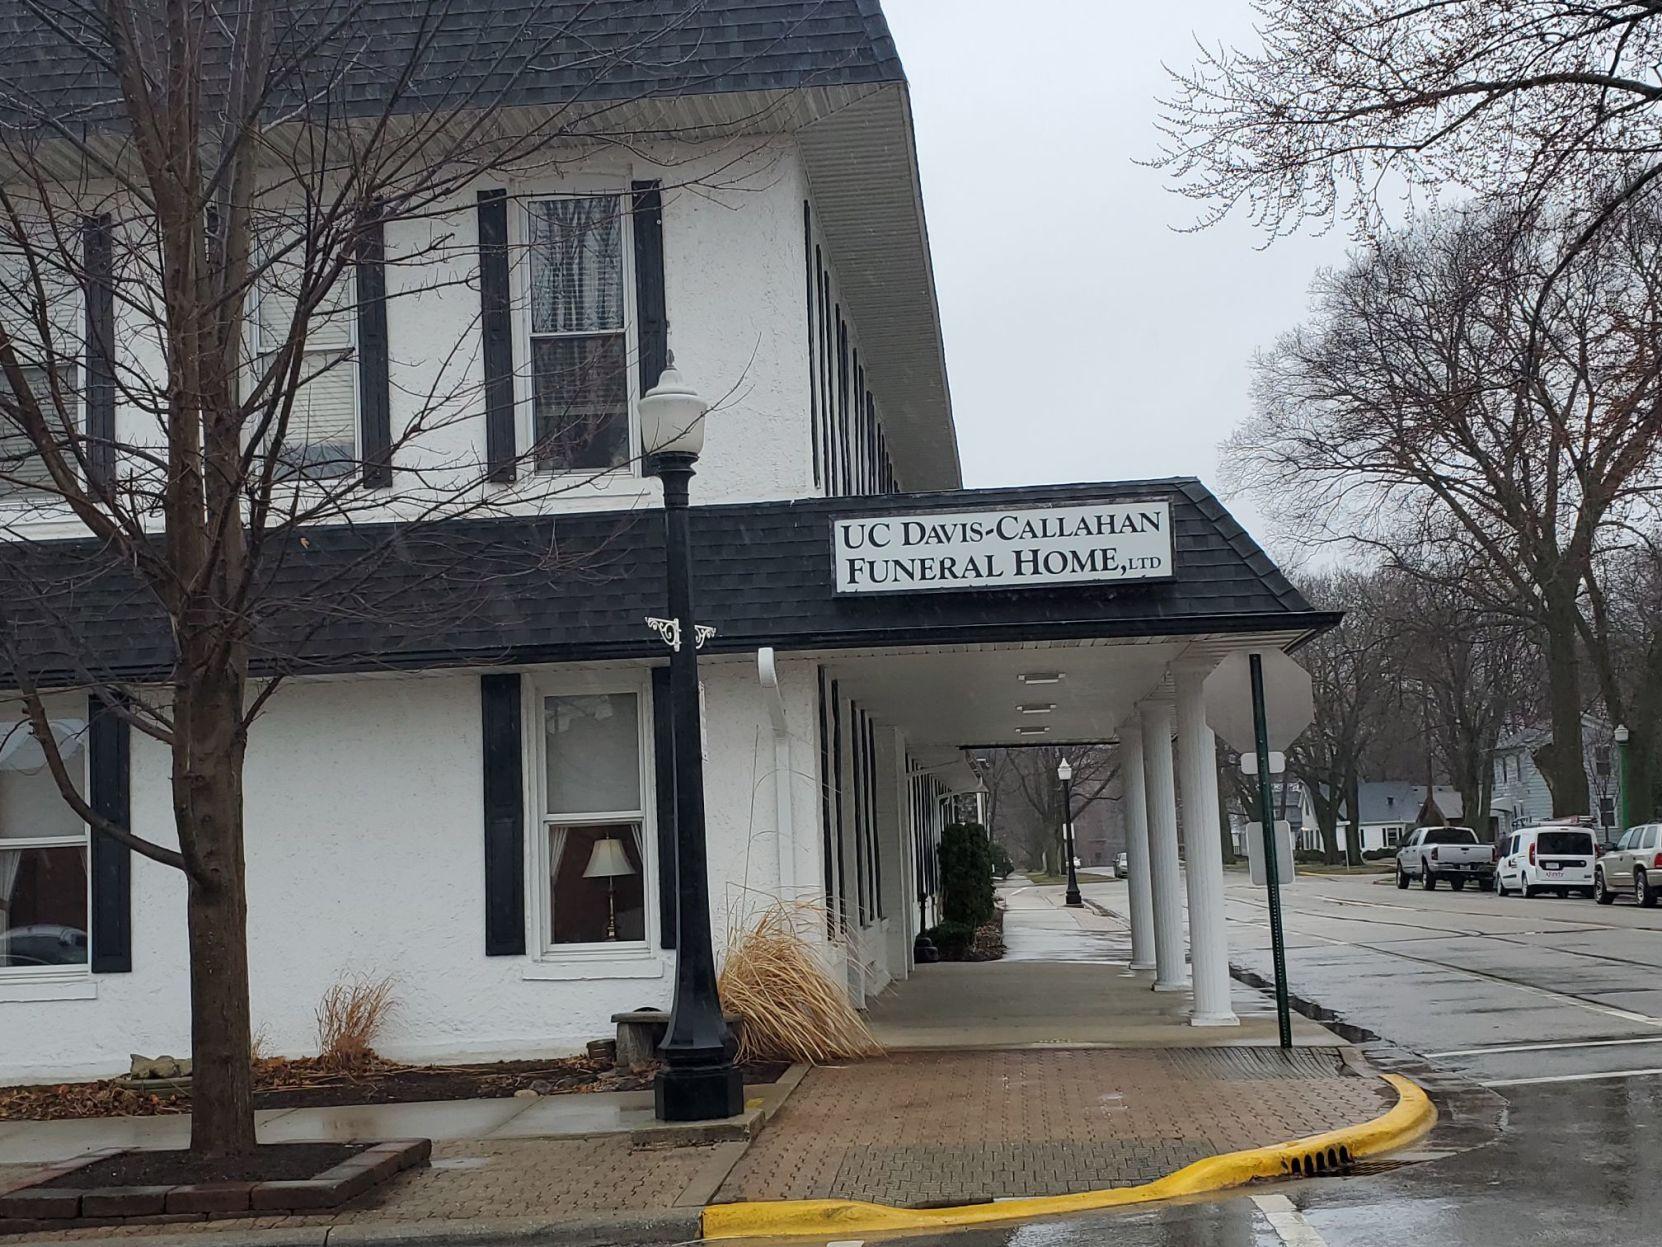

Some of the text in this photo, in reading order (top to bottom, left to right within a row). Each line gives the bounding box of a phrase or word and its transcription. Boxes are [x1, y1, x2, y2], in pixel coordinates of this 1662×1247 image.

[841, 512, 1162, 549] UC DAVIS-CALLAHAN
[846, 555, 1005, 585] FUNERAL
